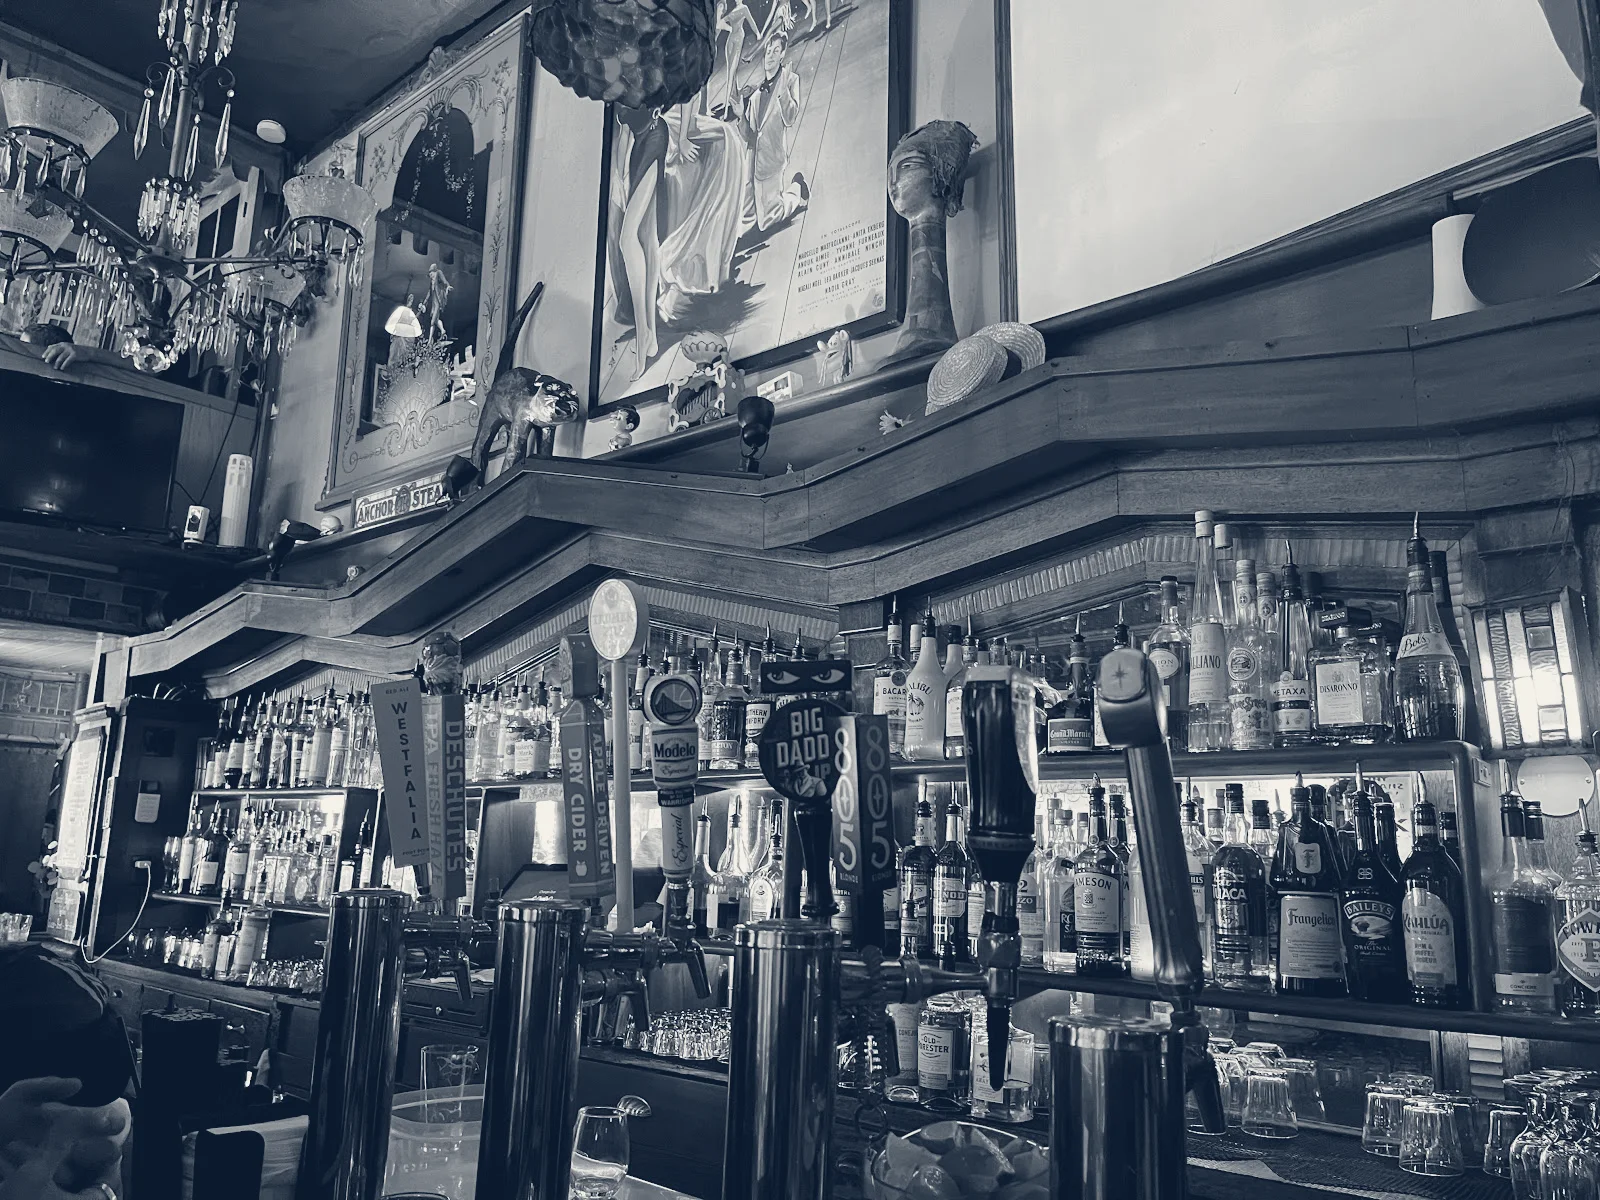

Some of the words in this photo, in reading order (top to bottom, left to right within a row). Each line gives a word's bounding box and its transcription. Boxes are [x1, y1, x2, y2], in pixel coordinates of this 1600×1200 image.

[357, 498, 394, 526] ANCHOR
[412, 484, 443, 507] STEA
[1402, 635, 1427, 655] Bols
[1191, 655, 1221, 669] LLIANO
[1319, 682, 1358, 694] DISARONNO
[747, 708, 768, 717] THERN
[790, 707, 824, 738] BIG
[654, 742, 696, 758] Modelo
[776, 733, 831, 769] DADD
[391, 701, 422, 840] WESTFALIA
[568, 747, 583, 786] DRY
[593, 733, 607, 797] APPLE
[815, 763, 831, 780] IP
[427, 761, 441, 827] FRESH
[446, 720, 464, 872] DESCHUTES
[834, 727, 857, 872] 805
[866, 725, 891, 870] 805
[570, 793, 588, 853] CIDER
[597, 801, 611, 875] DRIVEN
[429, 829, 443, 887] HAZE
[1019, 880, 1028, 893] 2
[1075, 877, 1112, 890] AMESON
[1190, 876, 1204, 884] ILLS
[1286, 908, 1336, 927] Frangelico
[1346, 902, 1392, 915] BAILEYS
[1402, 913, 1450, 936] KAHLÚA
[1562, 921, 1600, 940] POWE
[923, 1036, 936, 1044] OLD
